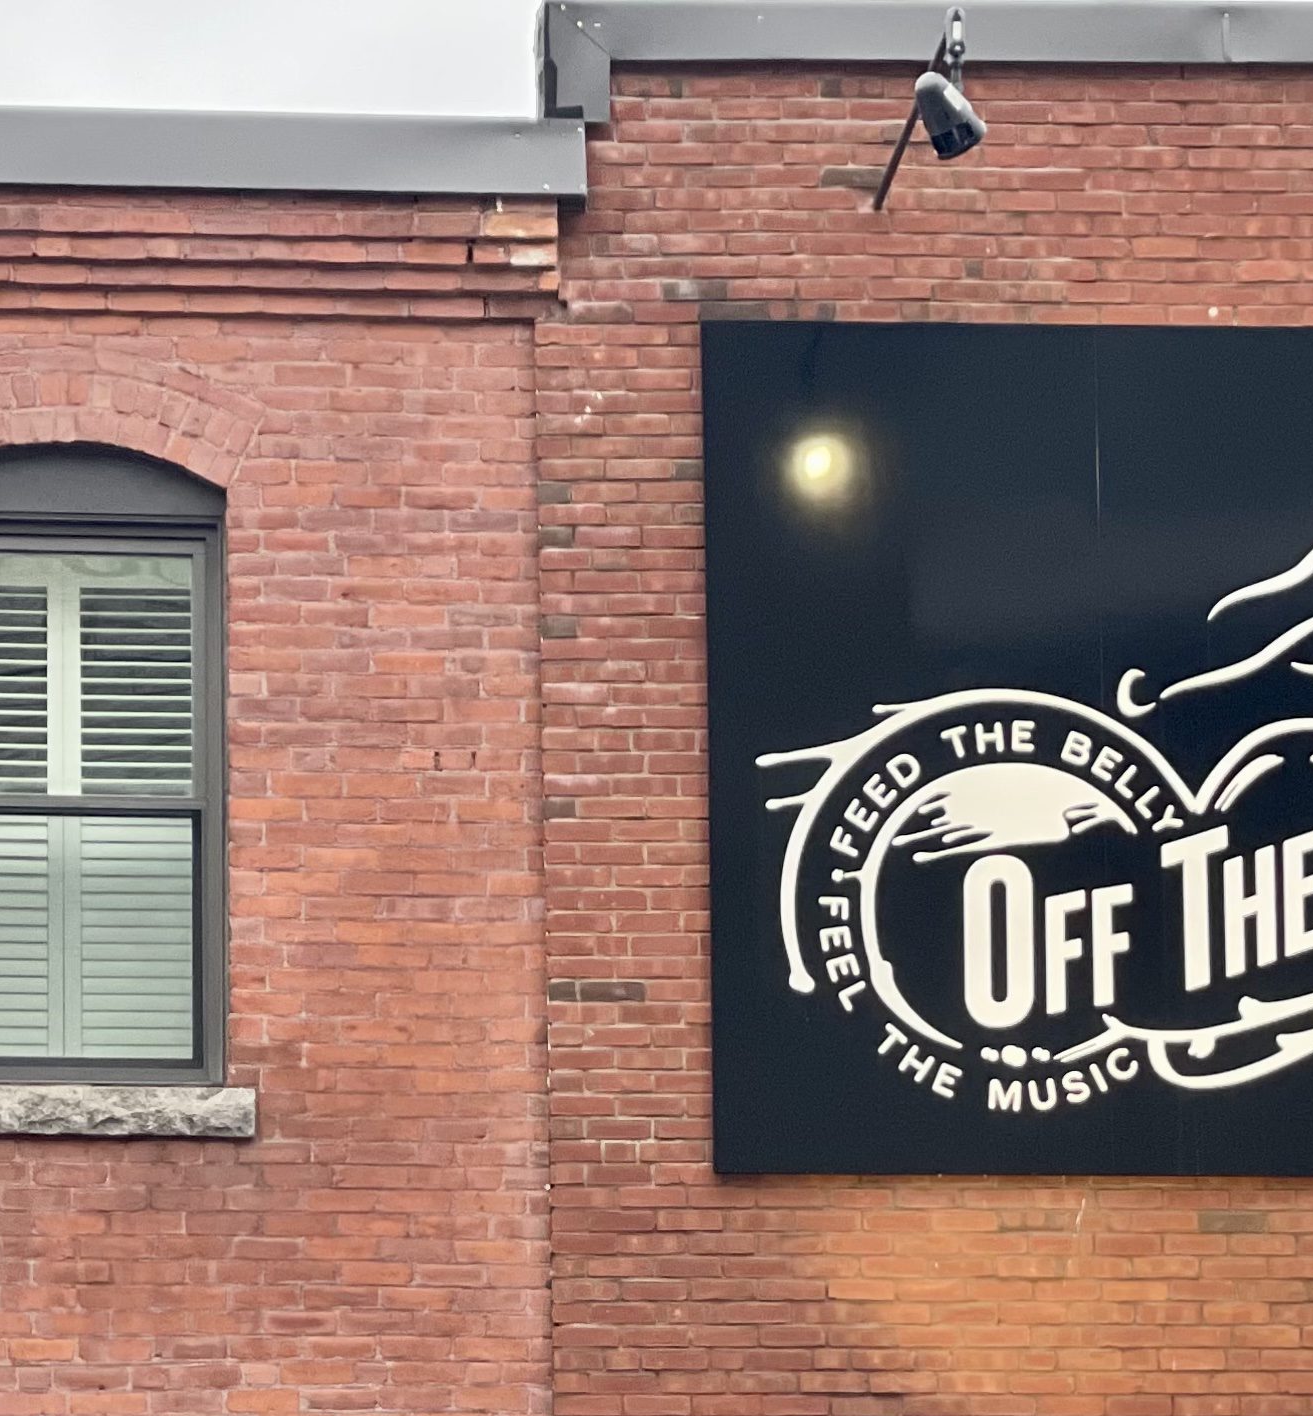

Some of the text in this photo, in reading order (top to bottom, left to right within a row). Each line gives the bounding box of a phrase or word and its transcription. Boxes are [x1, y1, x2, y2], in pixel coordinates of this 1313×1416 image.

[830, 720, 1184, 857] FEED THE BELLY
[818, 896, 1139, 1112] FEEL THE MUSIC
[963, 854, 1134, 1029] OFF
